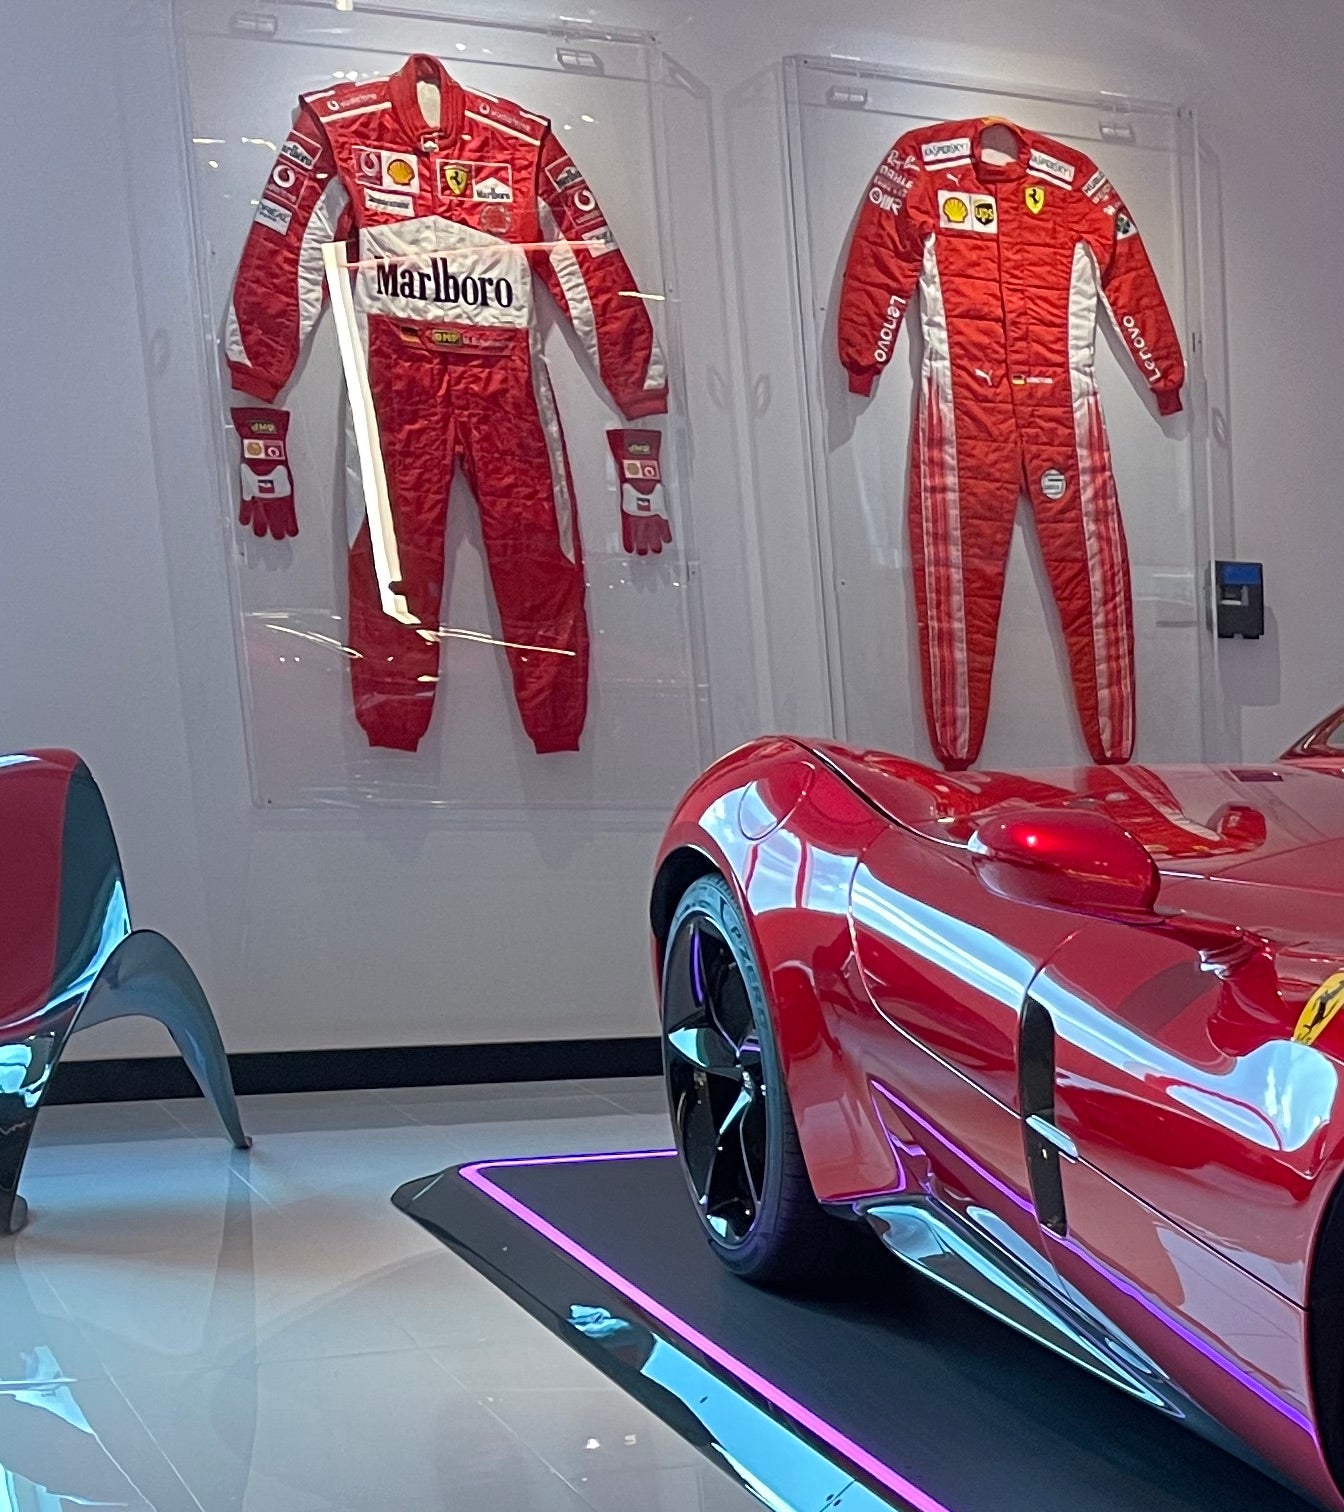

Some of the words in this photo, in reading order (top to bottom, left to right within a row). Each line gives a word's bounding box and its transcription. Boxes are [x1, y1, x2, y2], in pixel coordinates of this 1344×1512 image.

[376, 257, 514, 308] Marlboro
[875, 295, 907, 363] Lenovo
[1122, 315, 1161, 383] Lenovo
